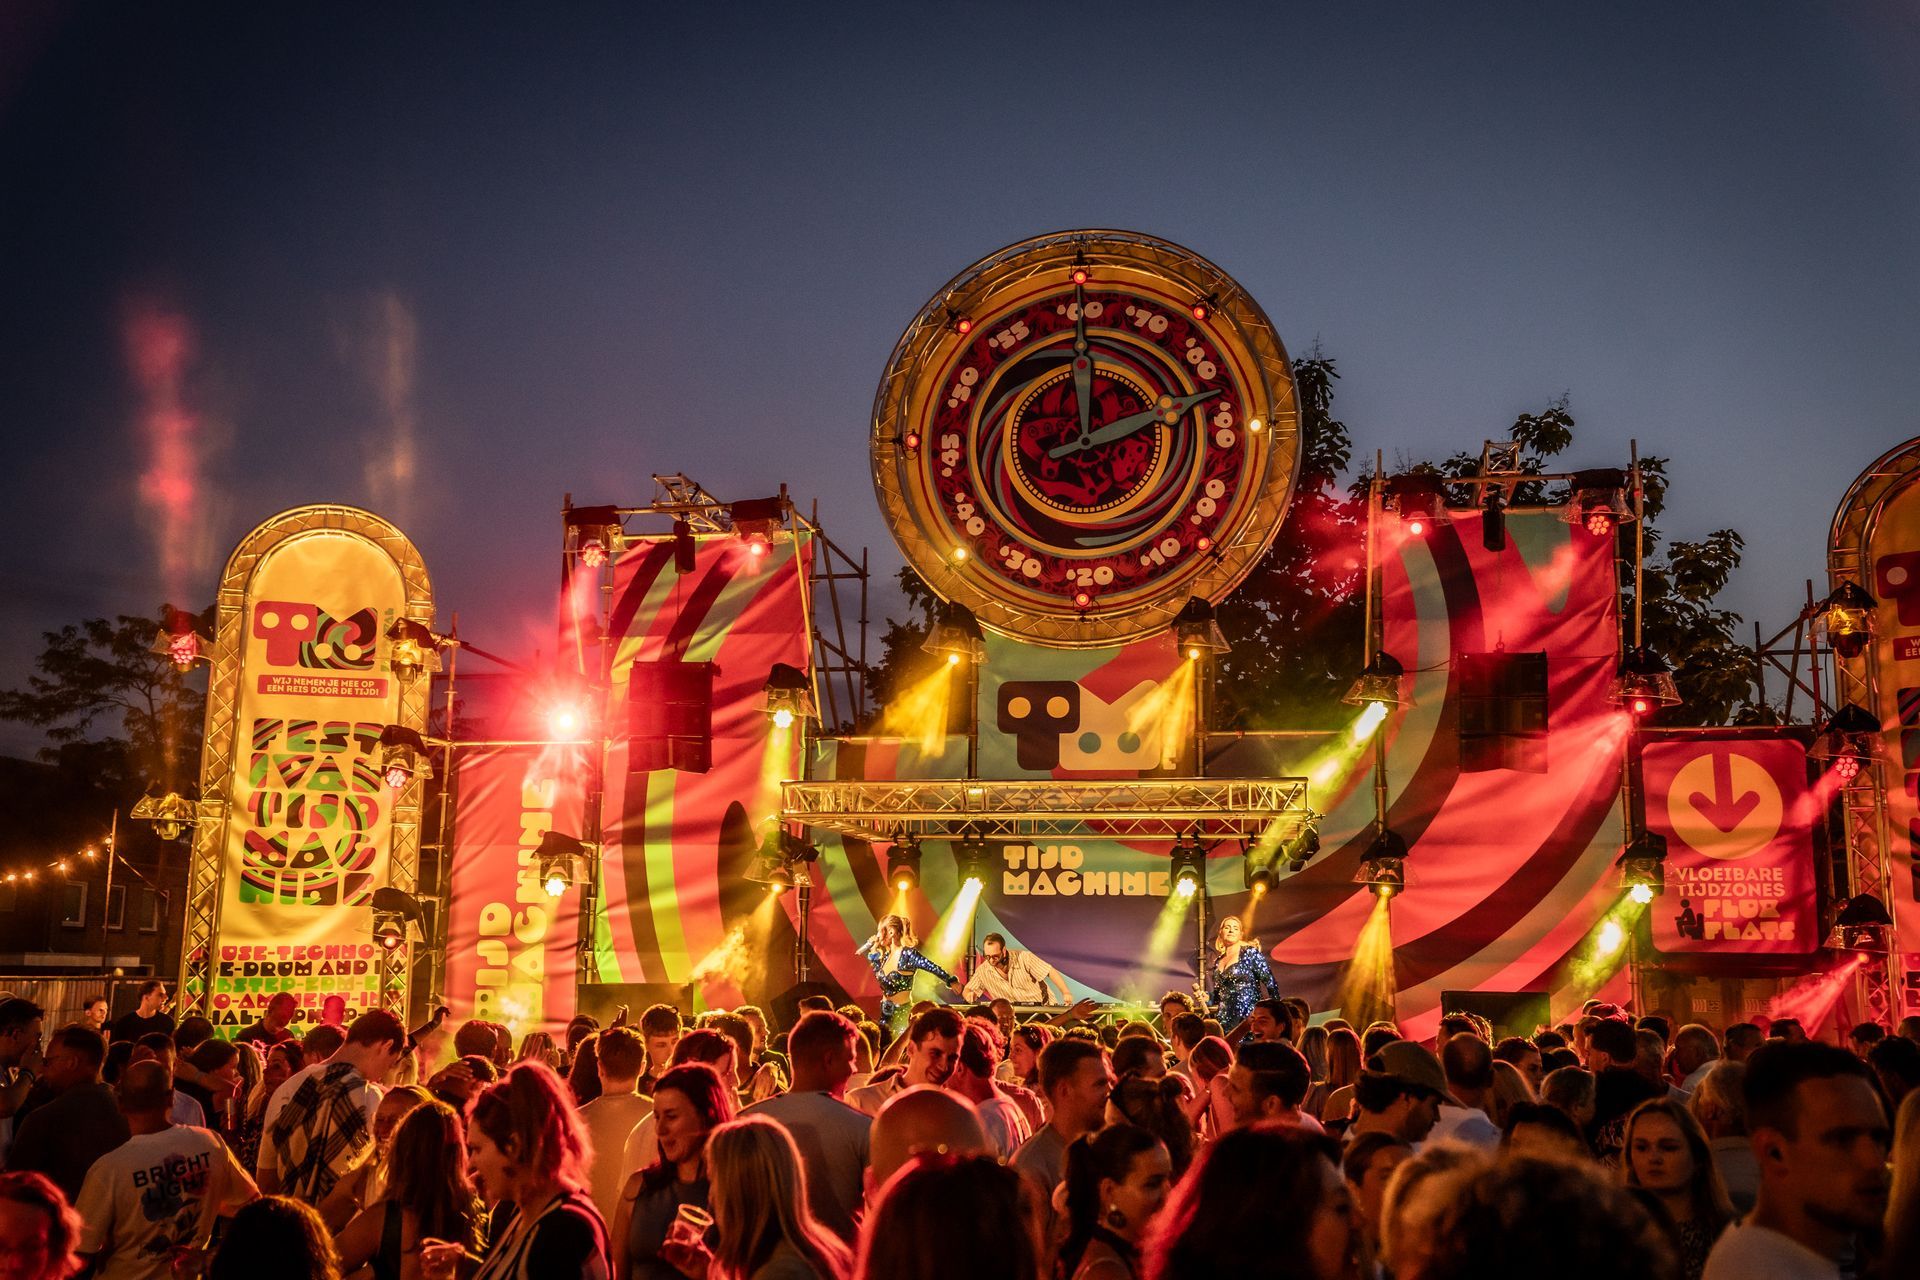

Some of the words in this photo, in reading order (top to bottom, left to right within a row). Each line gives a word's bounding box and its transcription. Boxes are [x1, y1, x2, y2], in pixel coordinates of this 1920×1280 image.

[272, 677, 291, 685] WIJ
[293, 677, 325, 687] NEMEN
[327, 679, 339, 687] JE
[341, 680, 359, 688] MEE
[361, 680, 375, 688] OP
[266, 684, 285, 692] EEN
[286, 685, 309, 693] REIS
[310, 686, 338, 695] DOOR
[340, 687, 353, 695] DE
[355, 687, 379, 696] TIJD!
[1003, 845, 1084, 870] TIJD
[1676, 868, 1783, 881] VLOEIBARE
[1003, 870, 1170, 896] MACHINE
[1678, 883, 1786, 897] TIJDZONES
[318, 961, 368, 976] AND
[132, 1151, 210, 1188] BRIGHT
